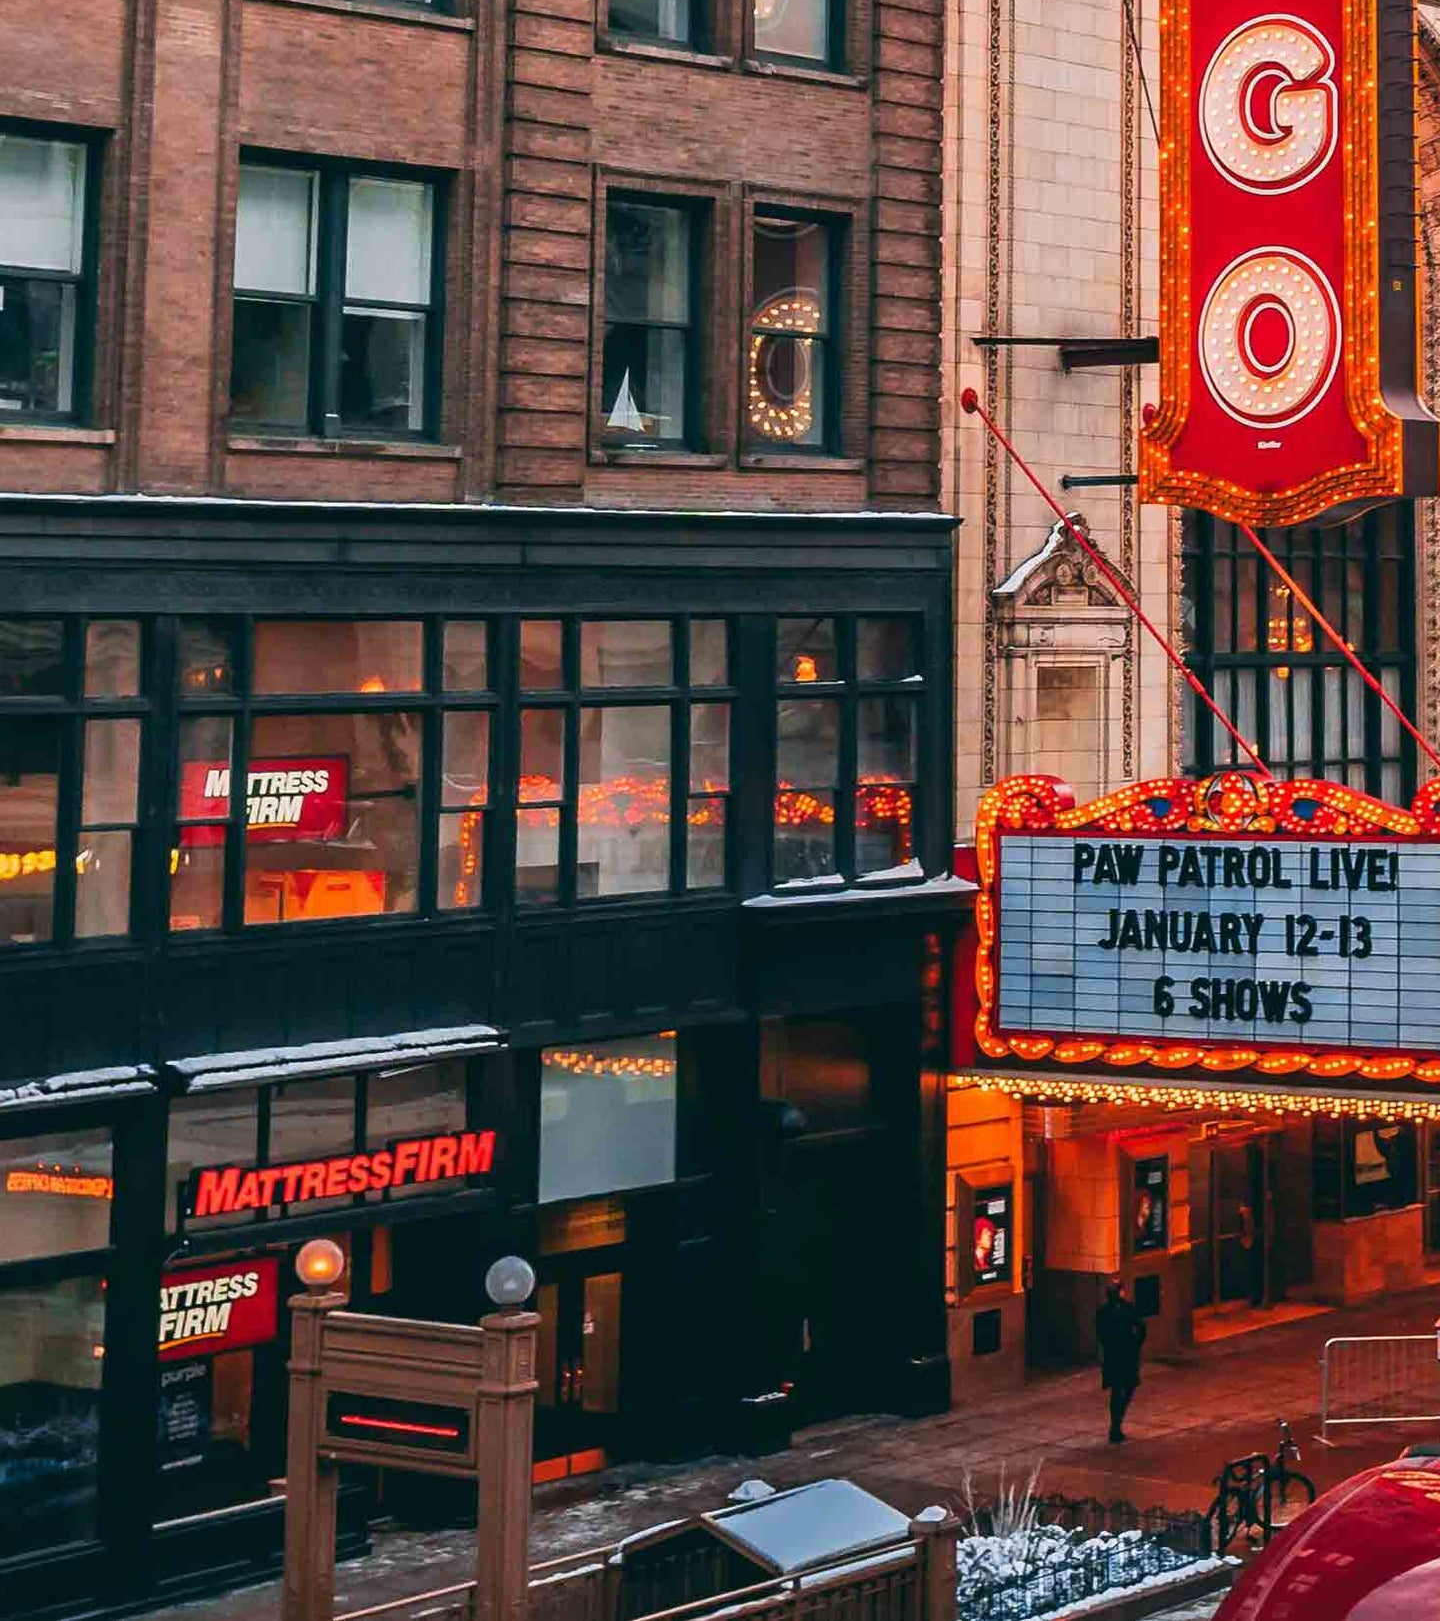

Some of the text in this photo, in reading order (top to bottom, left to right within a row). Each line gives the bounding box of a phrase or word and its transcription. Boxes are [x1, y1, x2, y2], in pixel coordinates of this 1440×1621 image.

[204, 769, 328, 797] MTTRESS
[1074, 843, 1399, 892] PAW PATROL LIVE!
[1098, 909, 1374, 959] JANUARY 12-13
[1154, 977, 1313, 1024] 6 SHOWS
[160, 1272, 259, 1311] ATTRESS
[158, 1302, 232, 1342] FIRM
